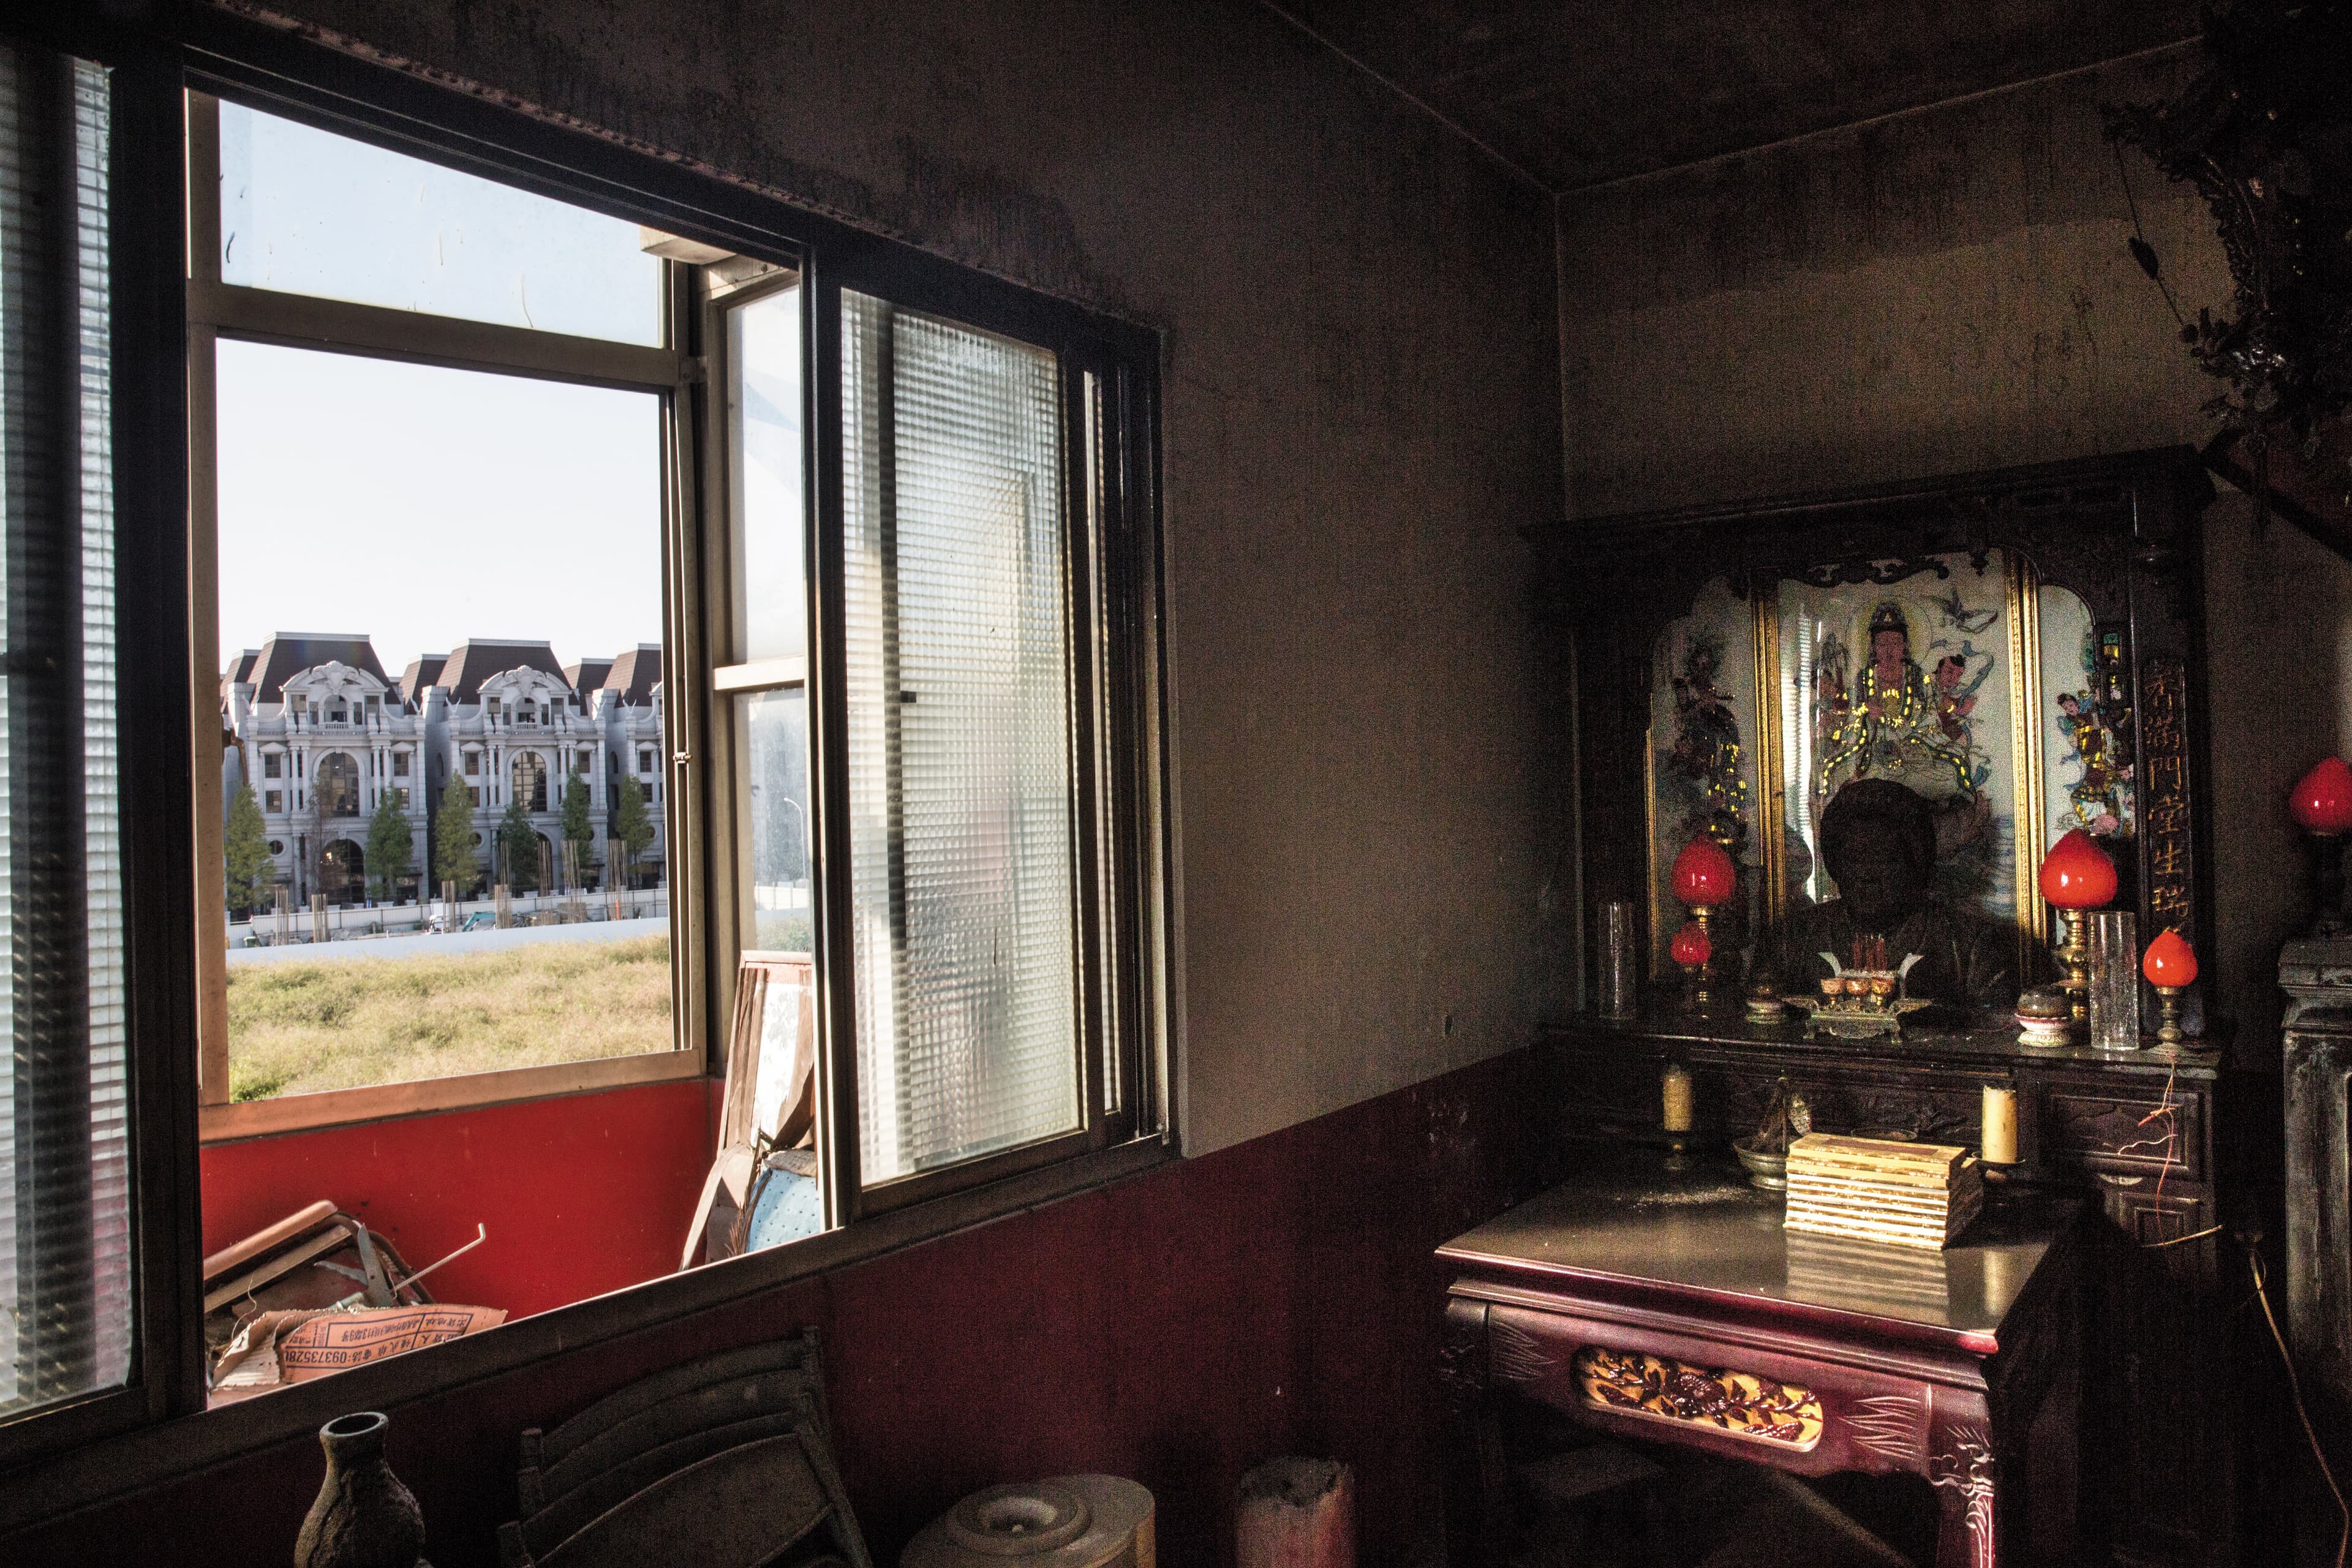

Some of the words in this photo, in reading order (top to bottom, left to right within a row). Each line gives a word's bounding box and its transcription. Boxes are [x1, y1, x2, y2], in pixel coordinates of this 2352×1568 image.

[2144, 669, 2190, 933] 香滿門堂生瑞
